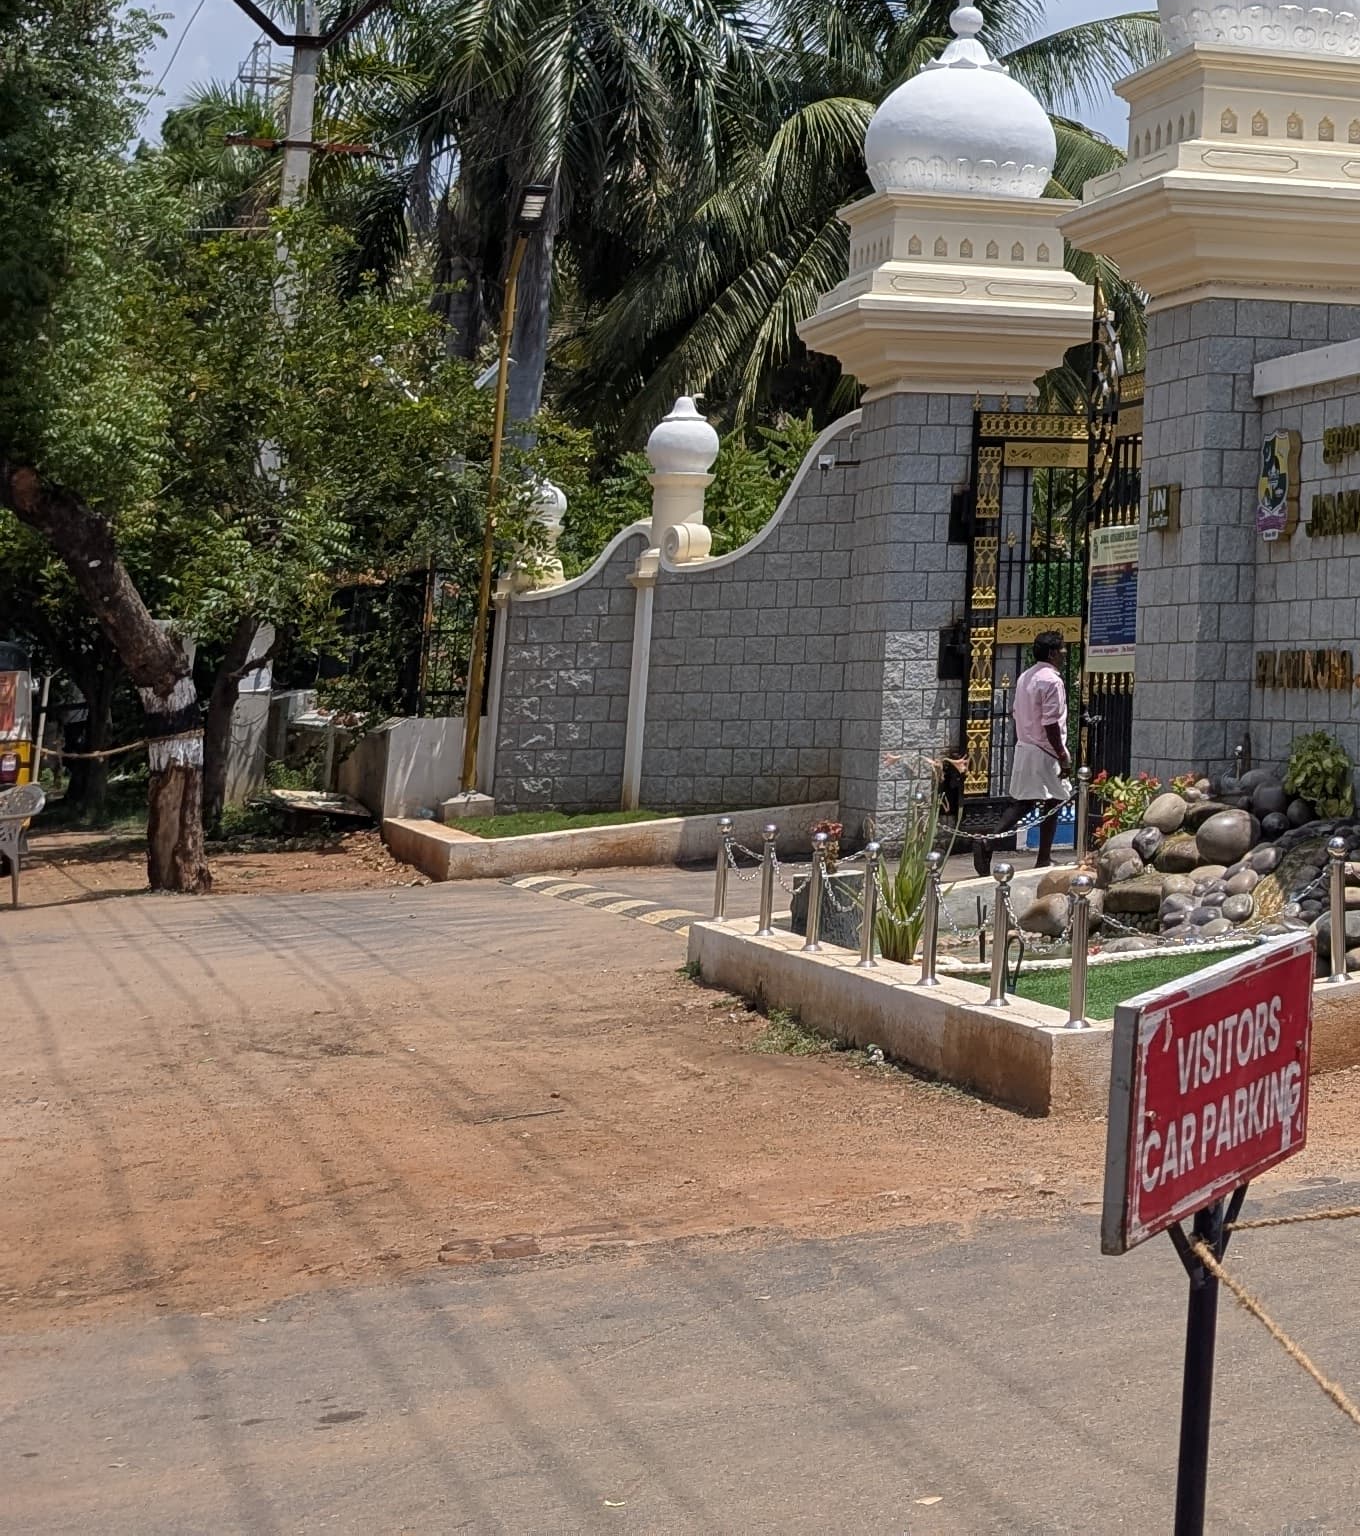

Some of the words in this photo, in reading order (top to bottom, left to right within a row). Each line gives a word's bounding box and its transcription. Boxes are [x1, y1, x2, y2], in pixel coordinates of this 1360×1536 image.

[1152, 487, 1167, 513] IN
[1255, 648, 1353, 690] PLATINUM
[1177, 995, 1282, 1095] VISITORS
[1142, 1112, 1196, 1192] CAR
[1200, 1060, 1301, 1165] PARKING
